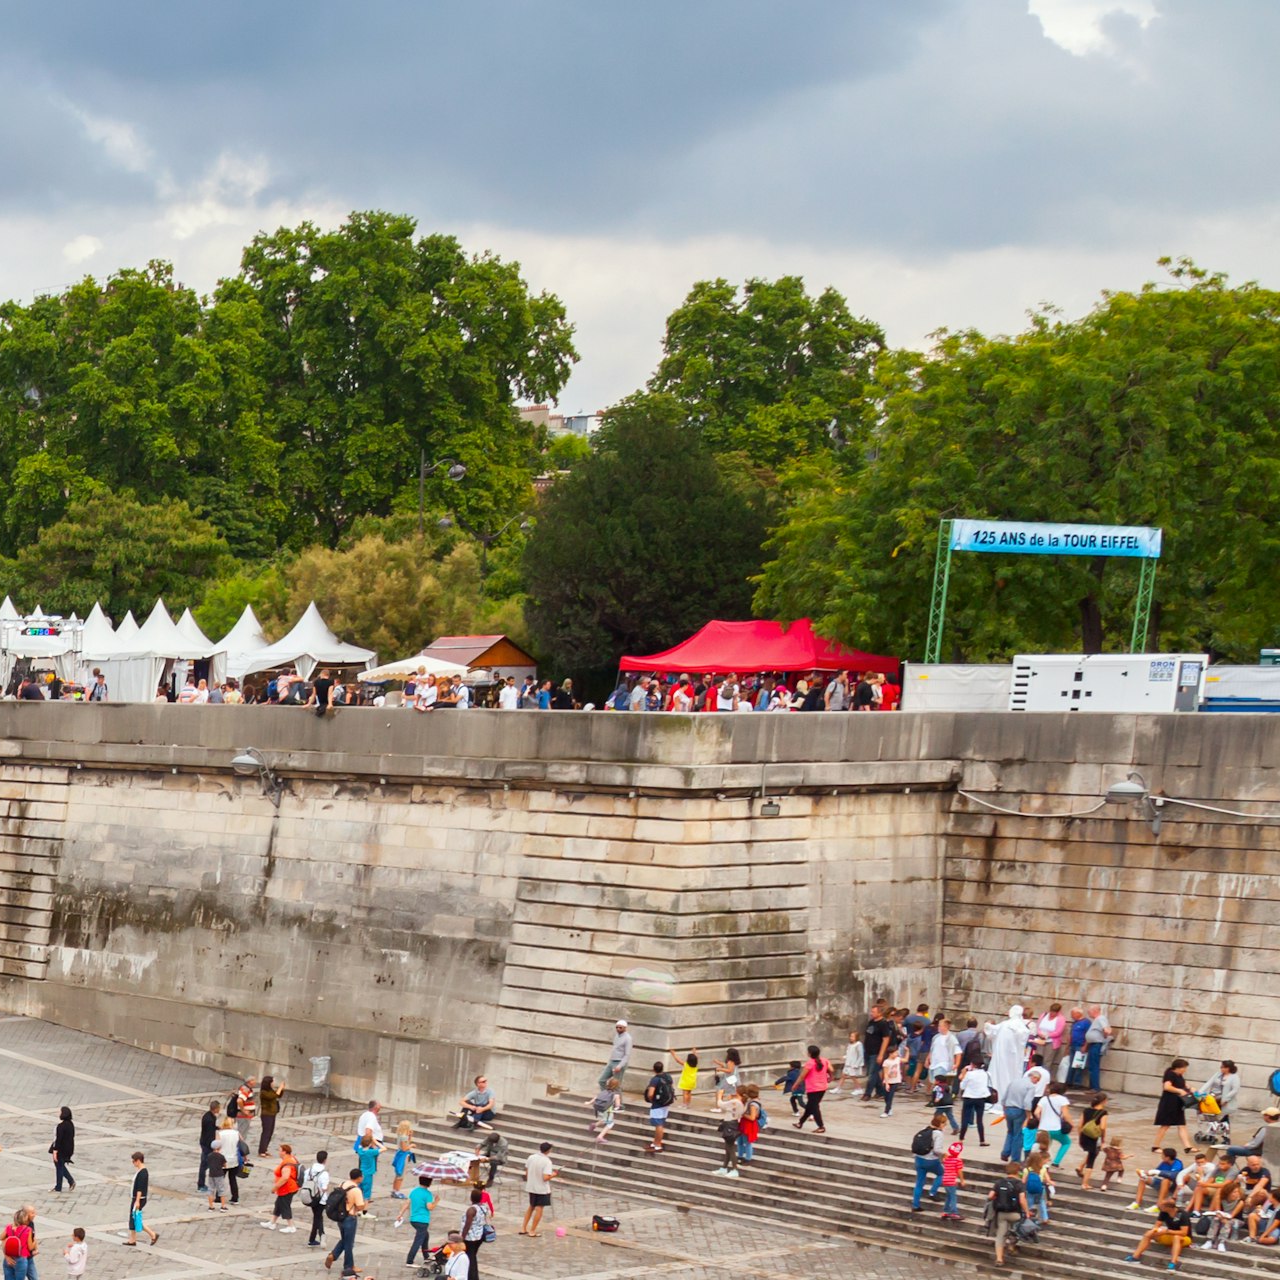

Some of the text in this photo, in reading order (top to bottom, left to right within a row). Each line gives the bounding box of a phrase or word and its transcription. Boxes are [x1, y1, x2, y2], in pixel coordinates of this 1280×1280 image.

[973, 530, 1140, 549] 125 ANS de la TOUR EIFFEL
